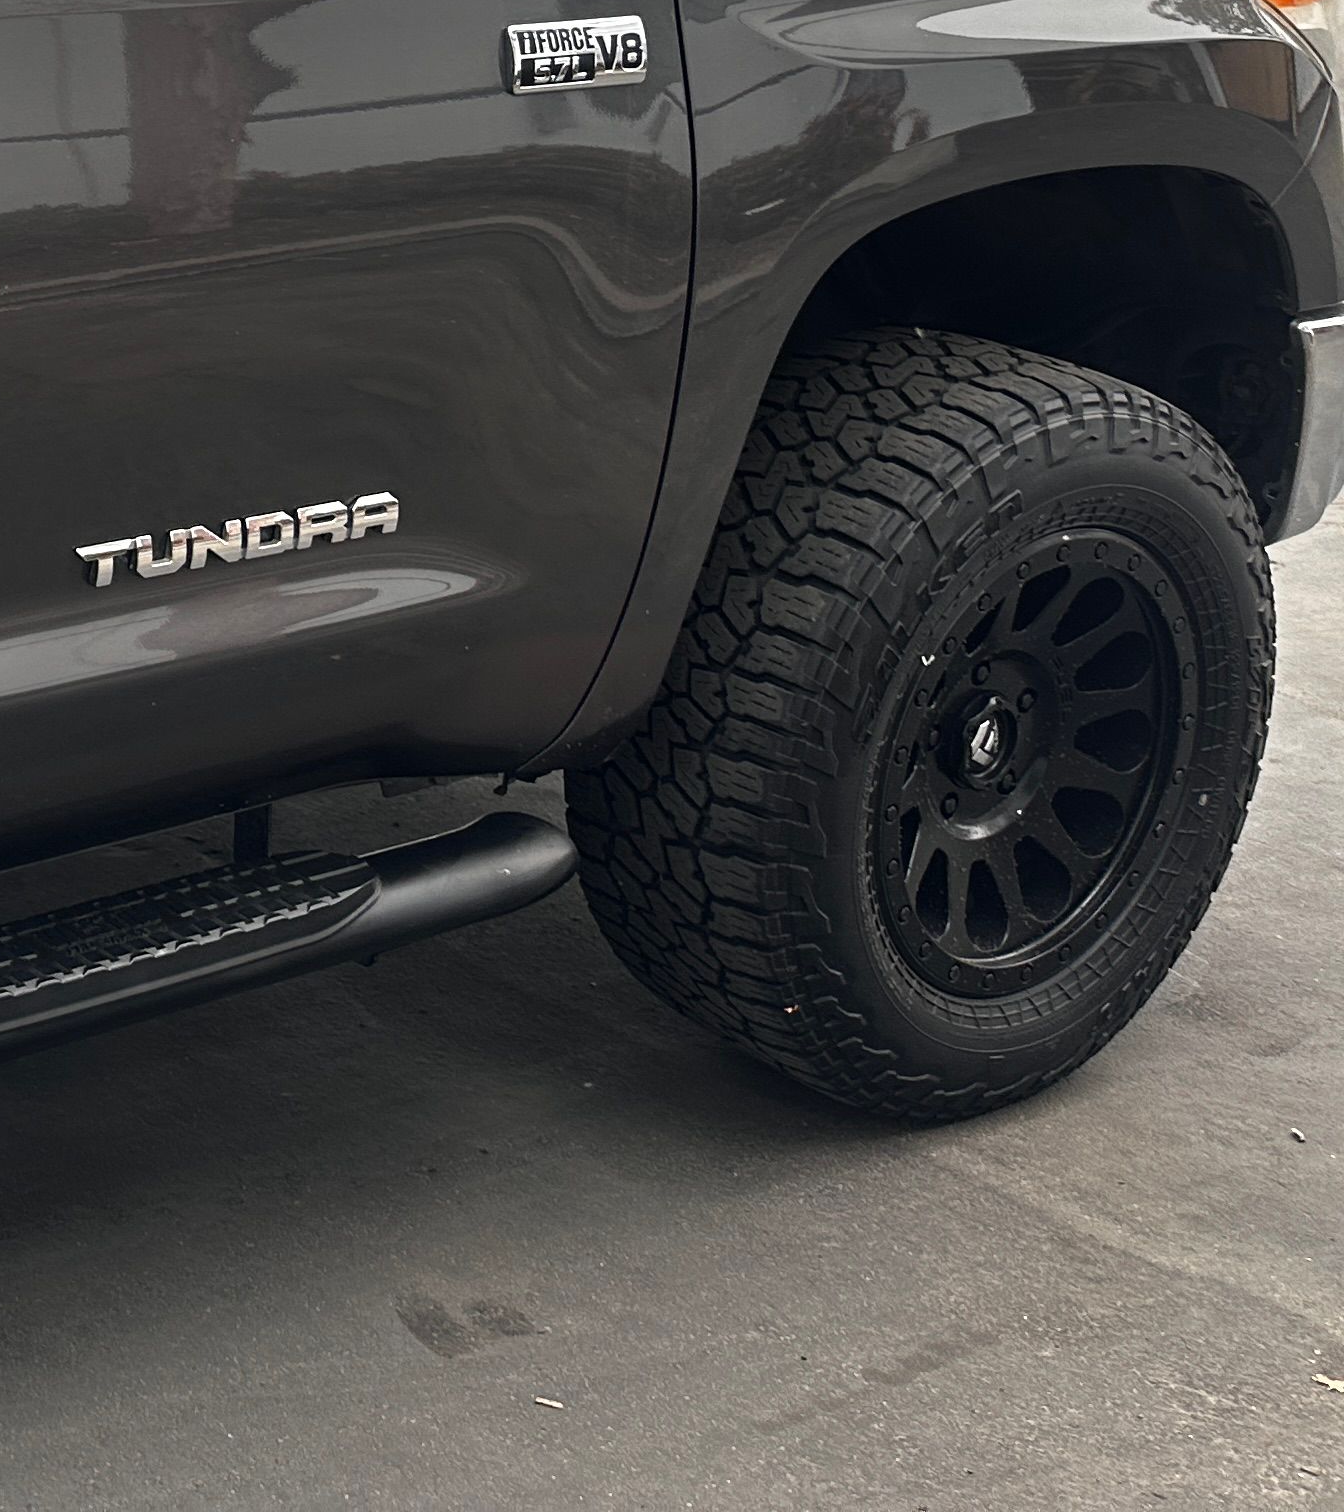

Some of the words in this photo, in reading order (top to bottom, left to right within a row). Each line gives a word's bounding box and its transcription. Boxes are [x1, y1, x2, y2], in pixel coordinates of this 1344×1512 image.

[533, 55, 589, 84] 5.7L
[595, 32, 644, 72] V8
[75, 491, 400, 588] TUNDRA
